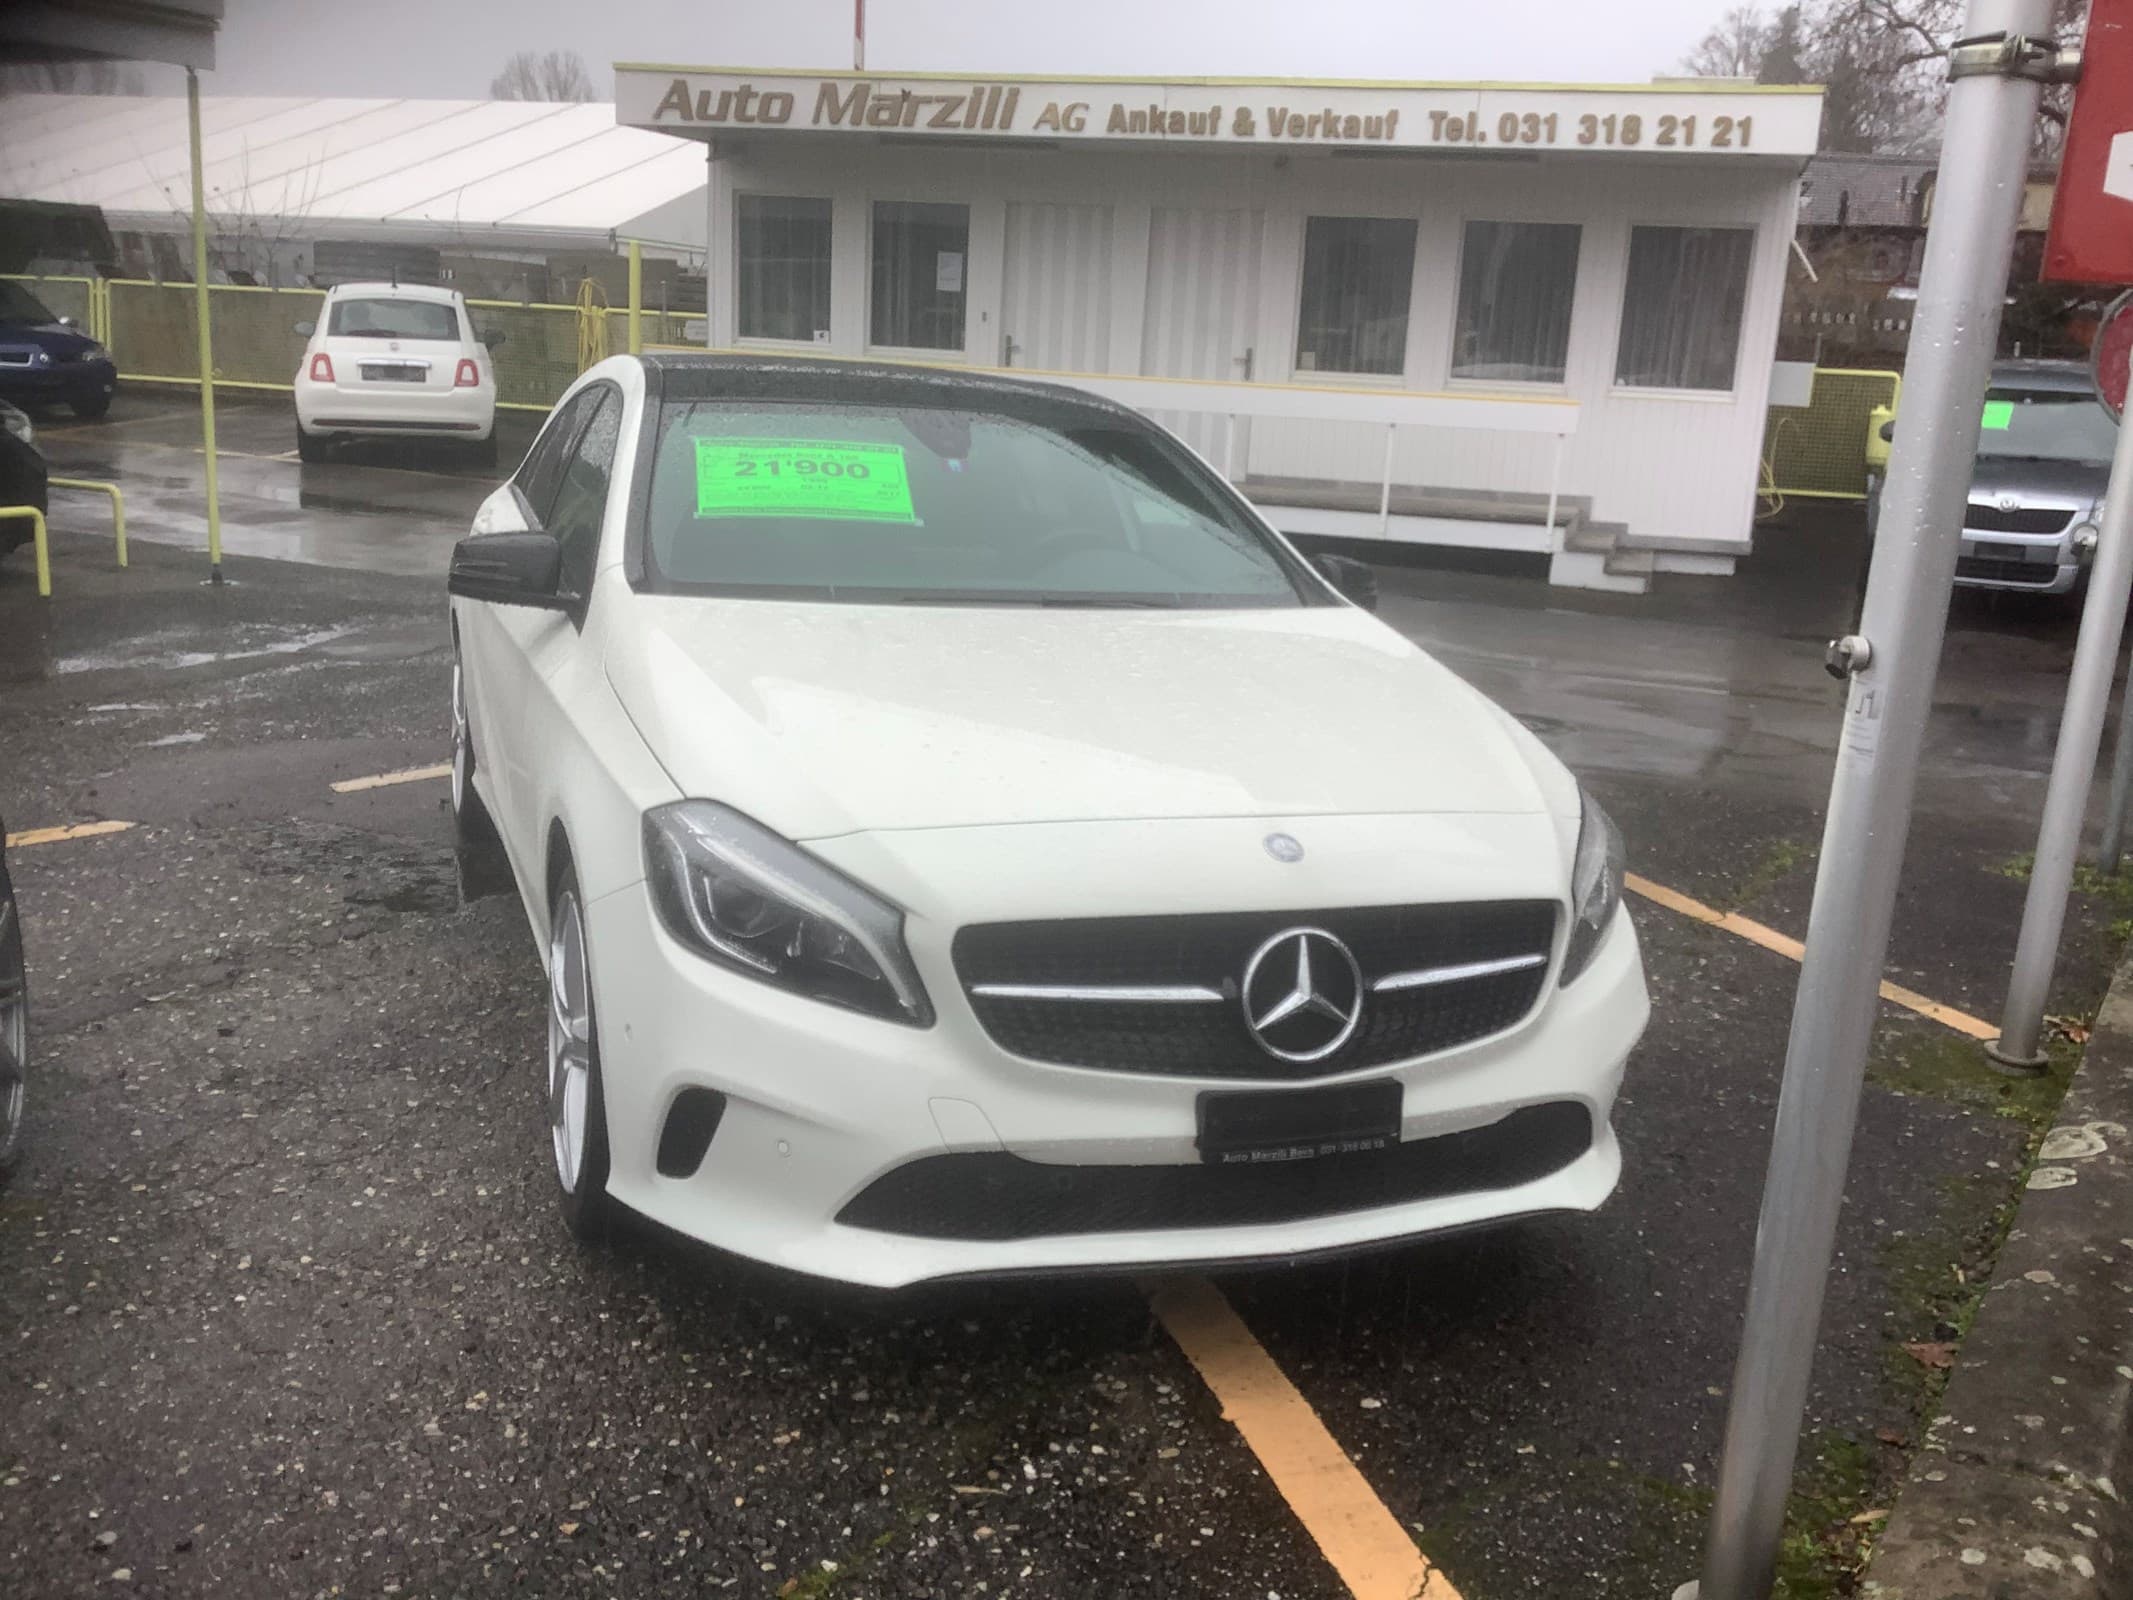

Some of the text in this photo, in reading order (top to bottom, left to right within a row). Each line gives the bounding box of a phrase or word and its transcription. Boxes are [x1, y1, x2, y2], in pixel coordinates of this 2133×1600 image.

[653, 79, 794, 123] Auto
[1032, 102, 1090, 132] AG
[1106, 103, 1222, 135] Ankauf
[1232, 107, 1255, 137] &
[1267, 106, 1399, 140] Verkauf
[1429, 110, 1486, 142] Tel.
[1498, 112, 1557, 144] 031
[1578, 114, 1641, 146] 318
[1655, 115, 1696, 146] 21
[1711, 116, 1753, 147] 21
[734, 459, 870, 480] 21'900
